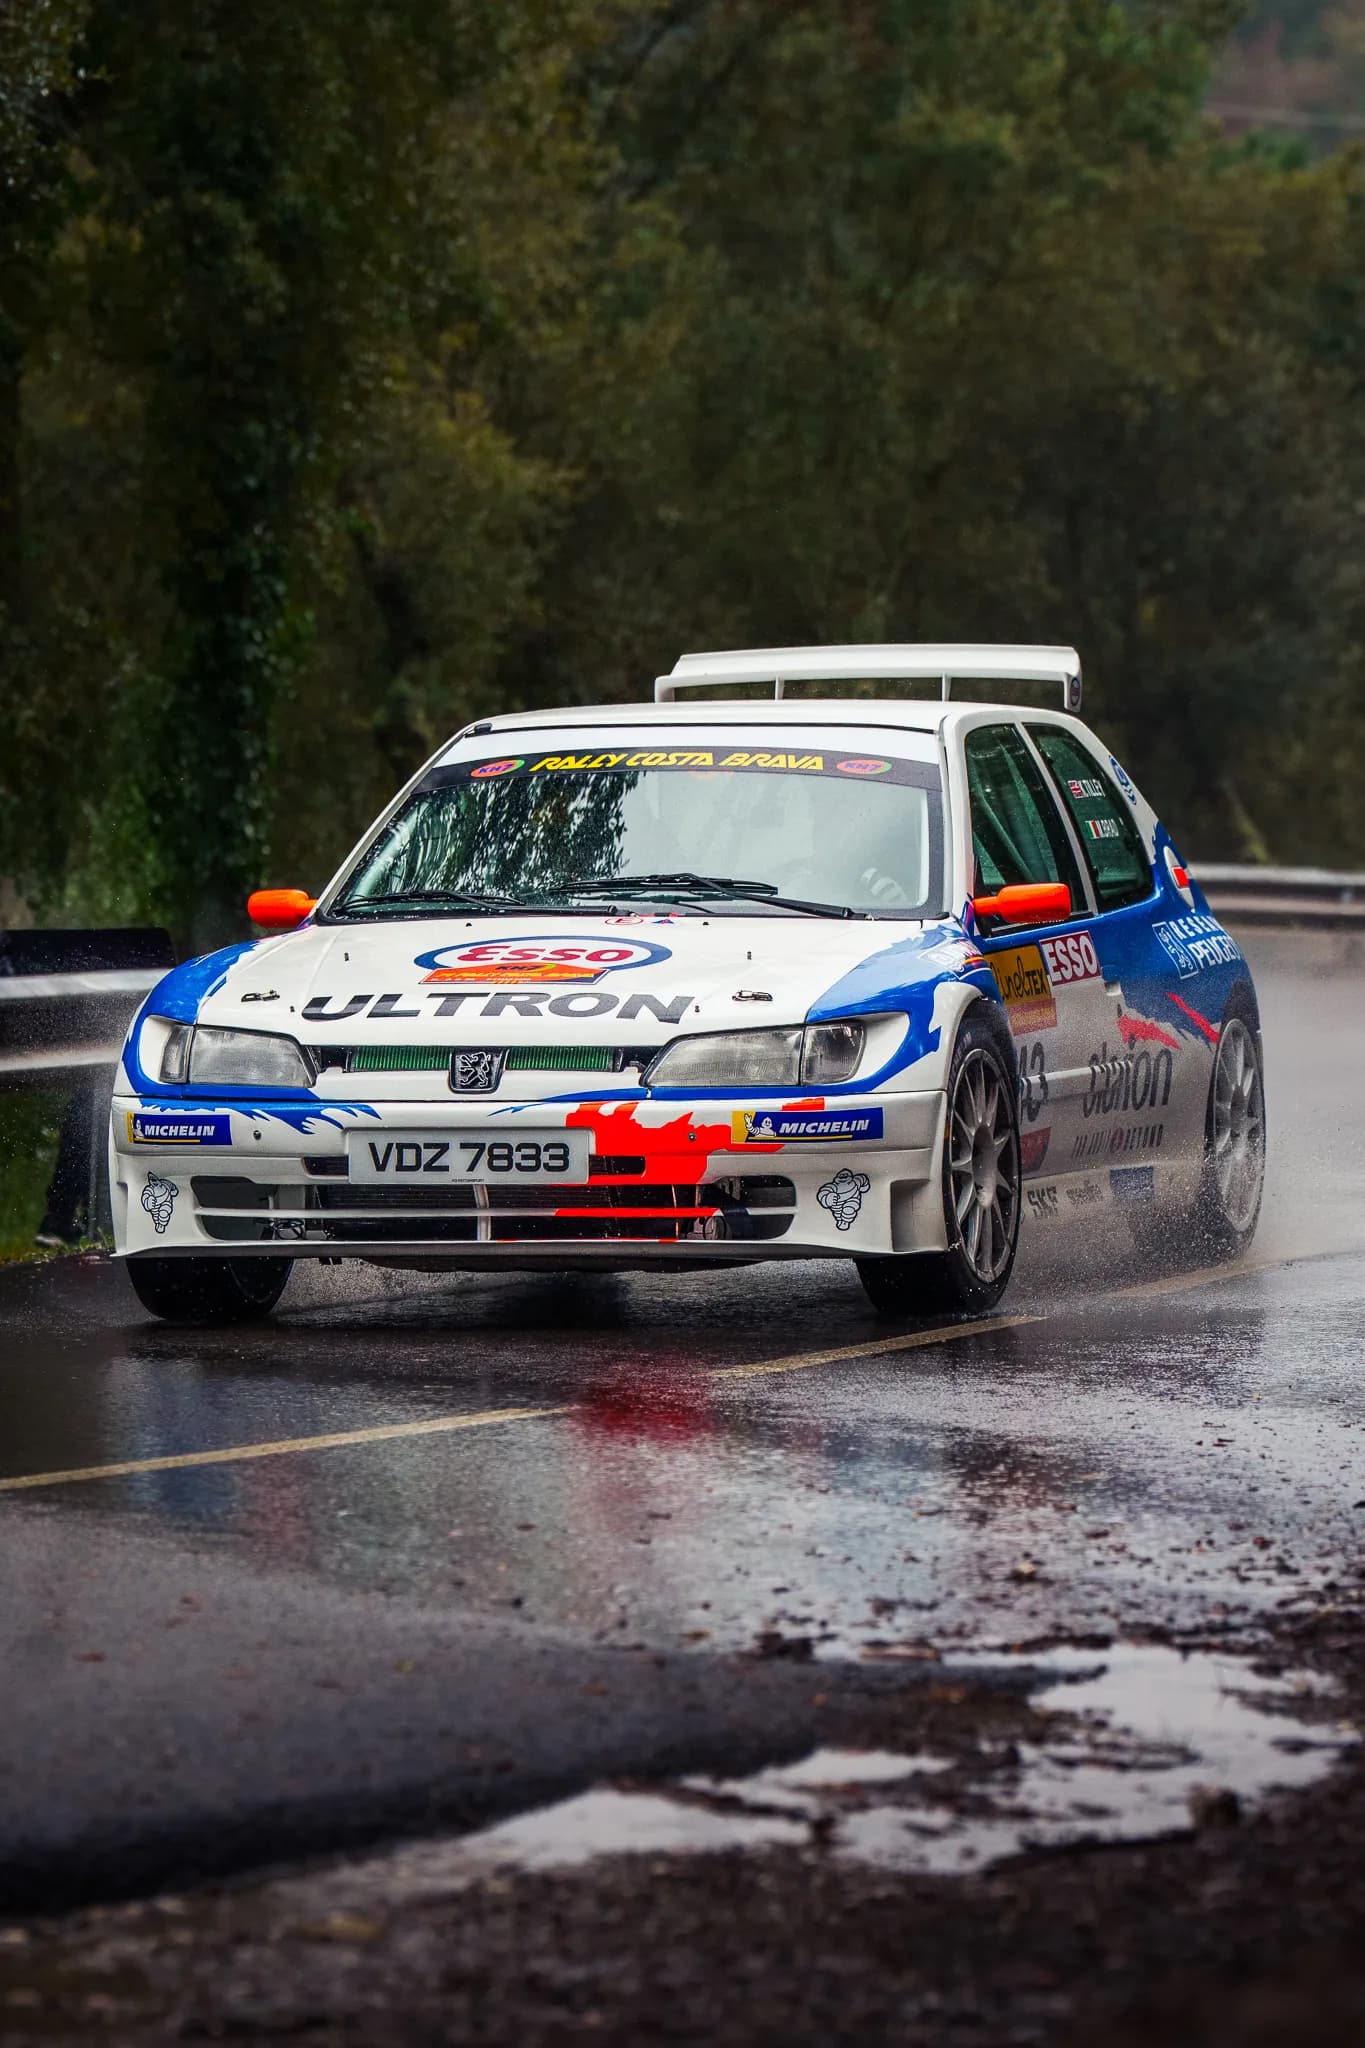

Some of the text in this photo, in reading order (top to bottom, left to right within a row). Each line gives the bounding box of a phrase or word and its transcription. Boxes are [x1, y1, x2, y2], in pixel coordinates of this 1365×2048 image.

[478, 763, 517, 775] KH7
[529, 752, 824, 772] RALLY COSTA BRAVA
[843, 761, 882, 772] KH7
[456, 944, 634, 963] ESSO
[1041, 935, 1098, 983] ESSO
[301, 992, 696, 1025] ULTRON
[1082, 1033, 1173, 1118] clarion
[144, 1123, 216, 1138] MICHELIN
[778, 1118, 870, 1136] MICHELIN
[368, 1142, 570, 1173] VDZ 7833
[1026, 1185, 1059, 1218] SKF
